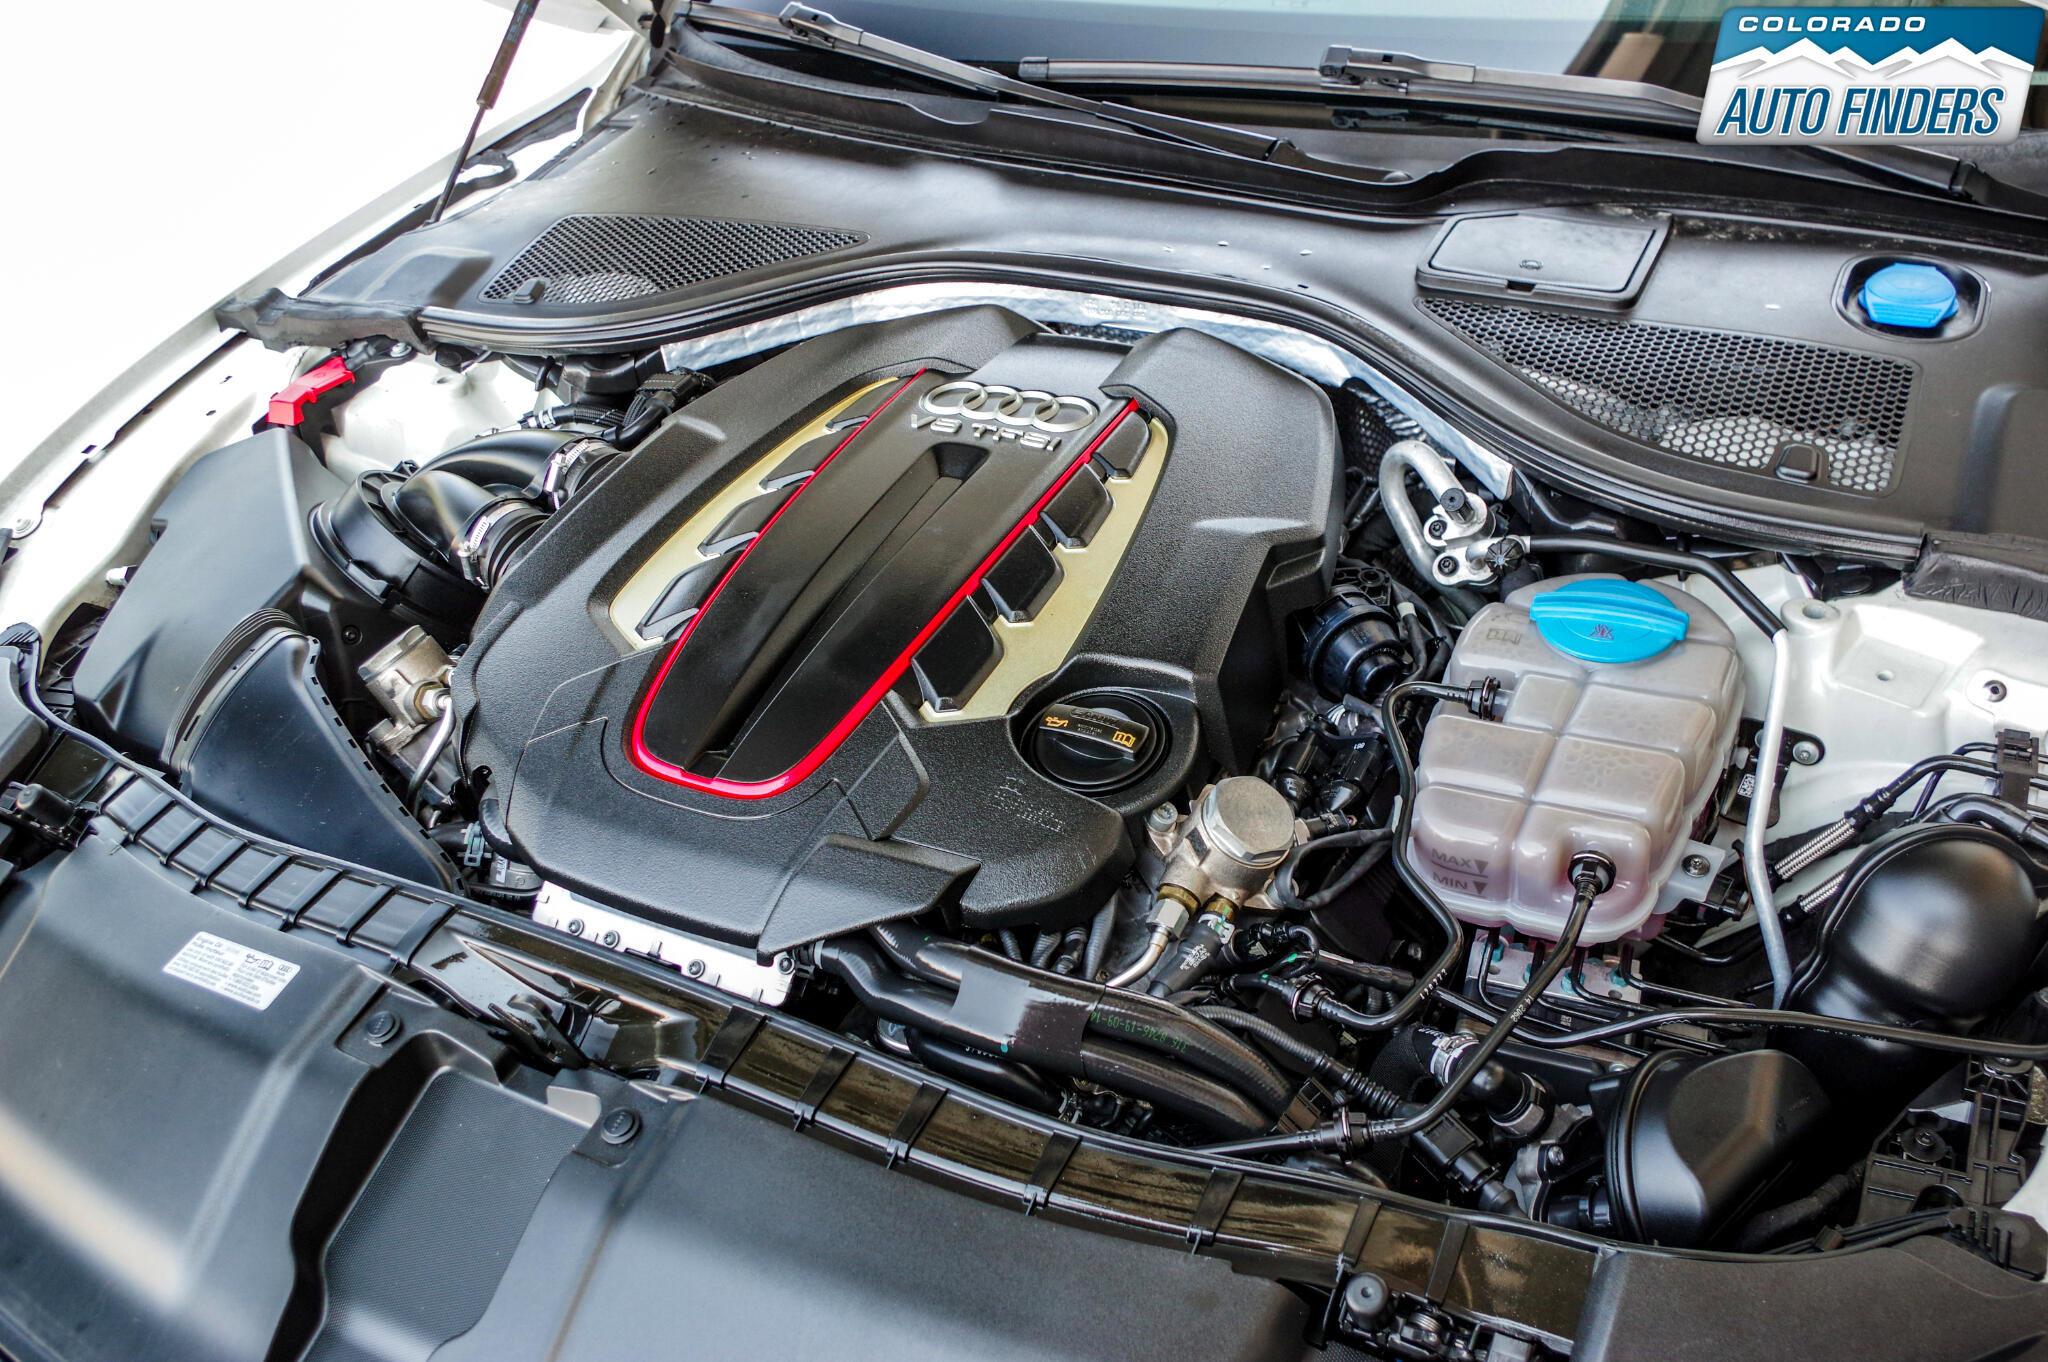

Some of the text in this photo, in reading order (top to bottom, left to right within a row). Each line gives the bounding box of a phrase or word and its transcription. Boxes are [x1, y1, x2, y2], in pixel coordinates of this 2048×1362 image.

[910, 413, 1062, 451] V8 TFSI
[1431, 848, 1472, 868] MAX
[1432, 872, 1468, 889] MIN
